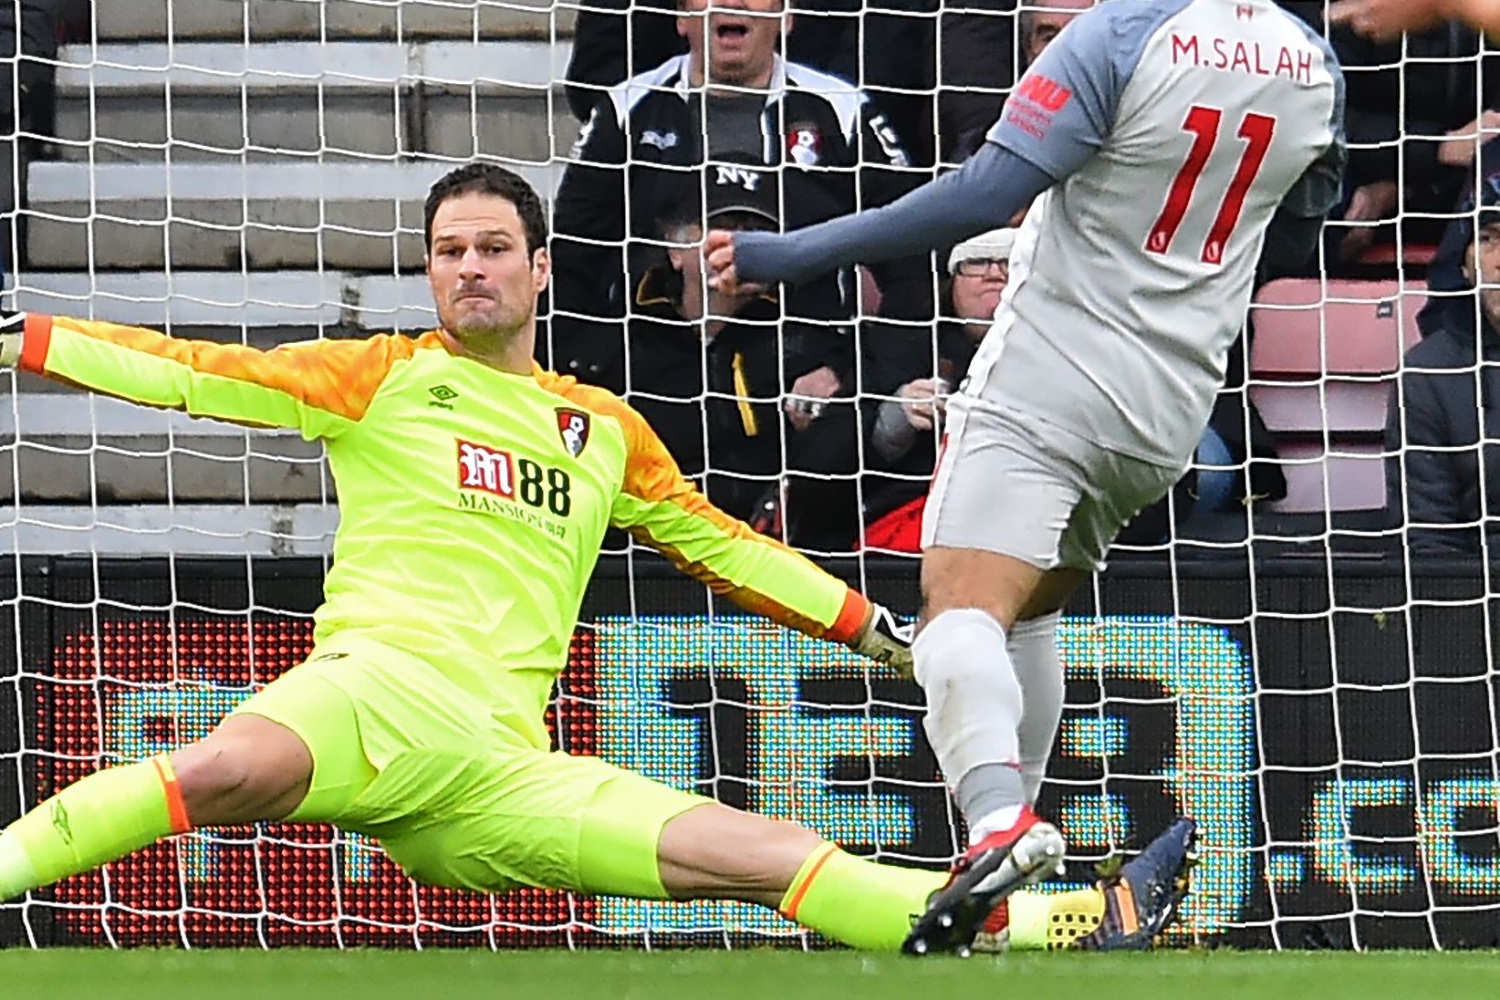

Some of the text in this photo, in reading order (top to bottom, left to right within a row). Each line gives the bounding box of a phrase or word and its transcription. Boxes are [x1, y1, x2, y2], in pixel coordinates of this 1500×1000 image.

[1171, 33, 1313, 84] M.SALAH
[716, 166, 760, 192] NY
[1143, 104, 1277, 266] 11
